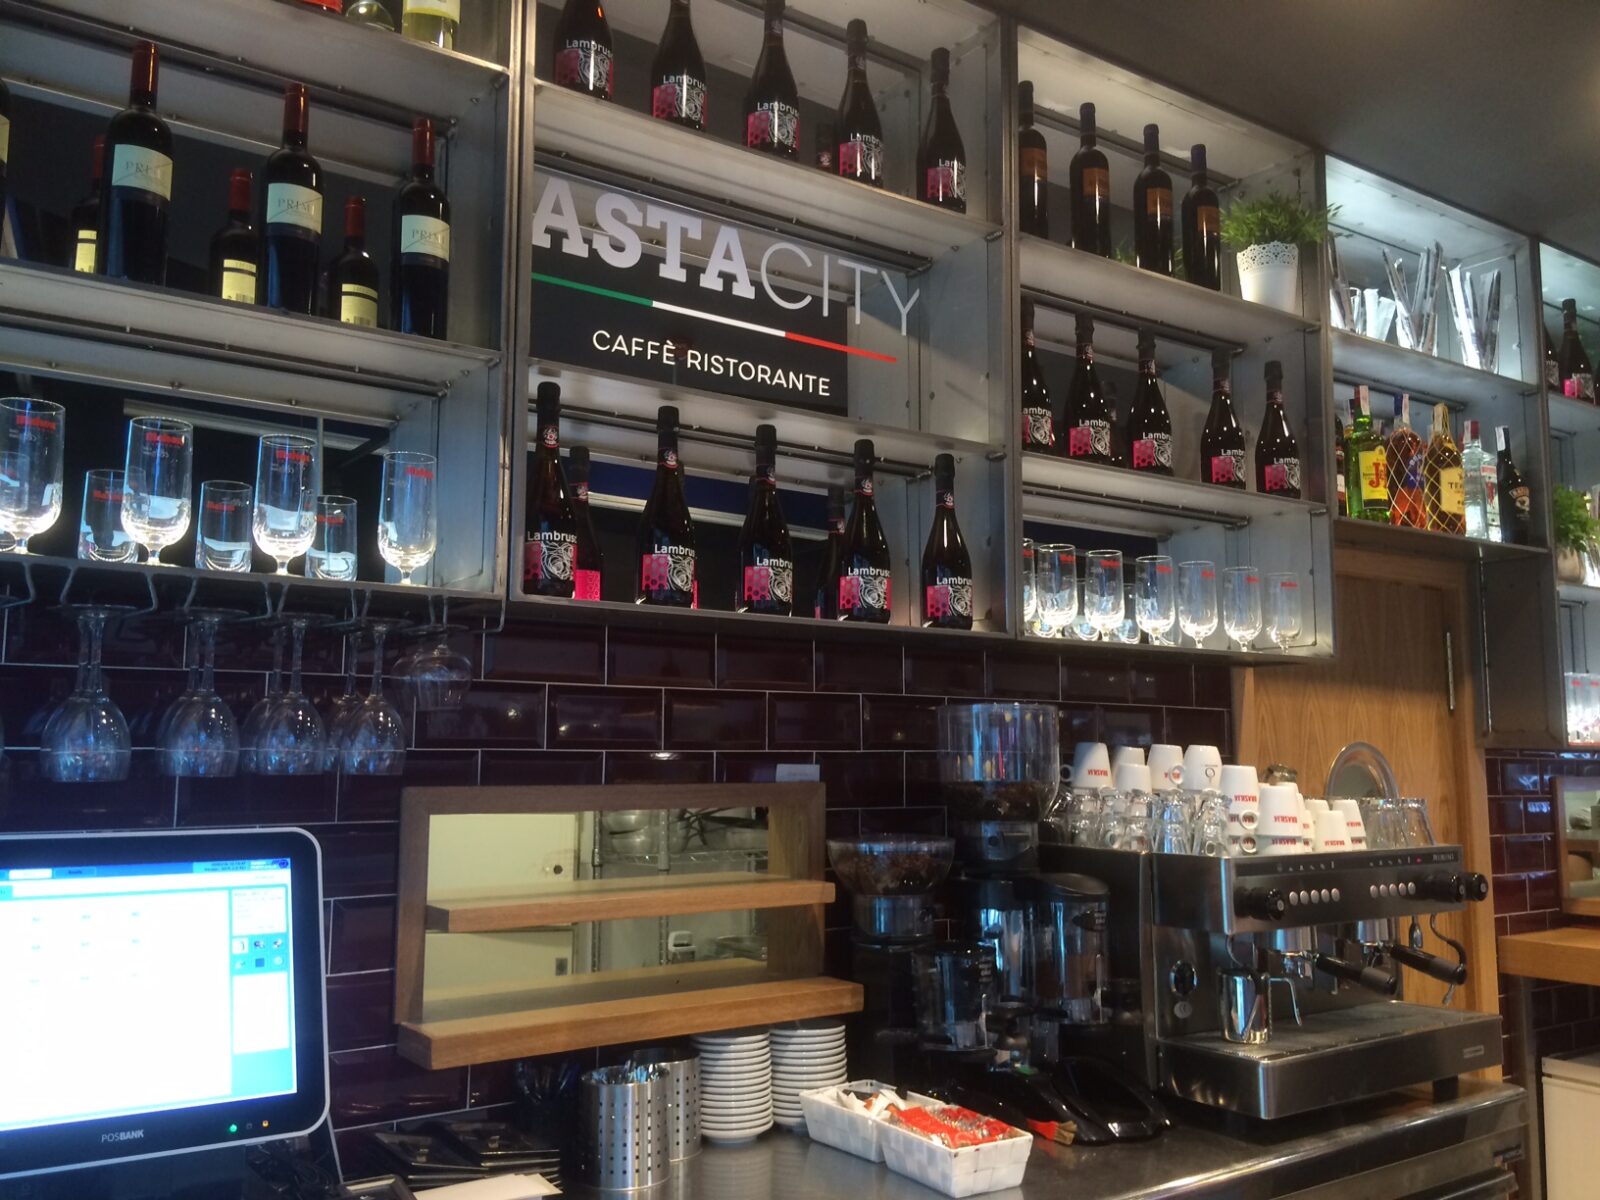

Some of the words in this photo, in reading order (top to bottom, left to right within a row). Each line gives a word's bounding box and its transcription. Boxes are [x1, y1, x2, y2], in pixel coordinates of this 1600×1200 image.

[592, 330, 676, 365] CAFFÈ
[687, 349, 831, 397] RISTORANTE
[101, 1130, 144, 1143] POSBANK
